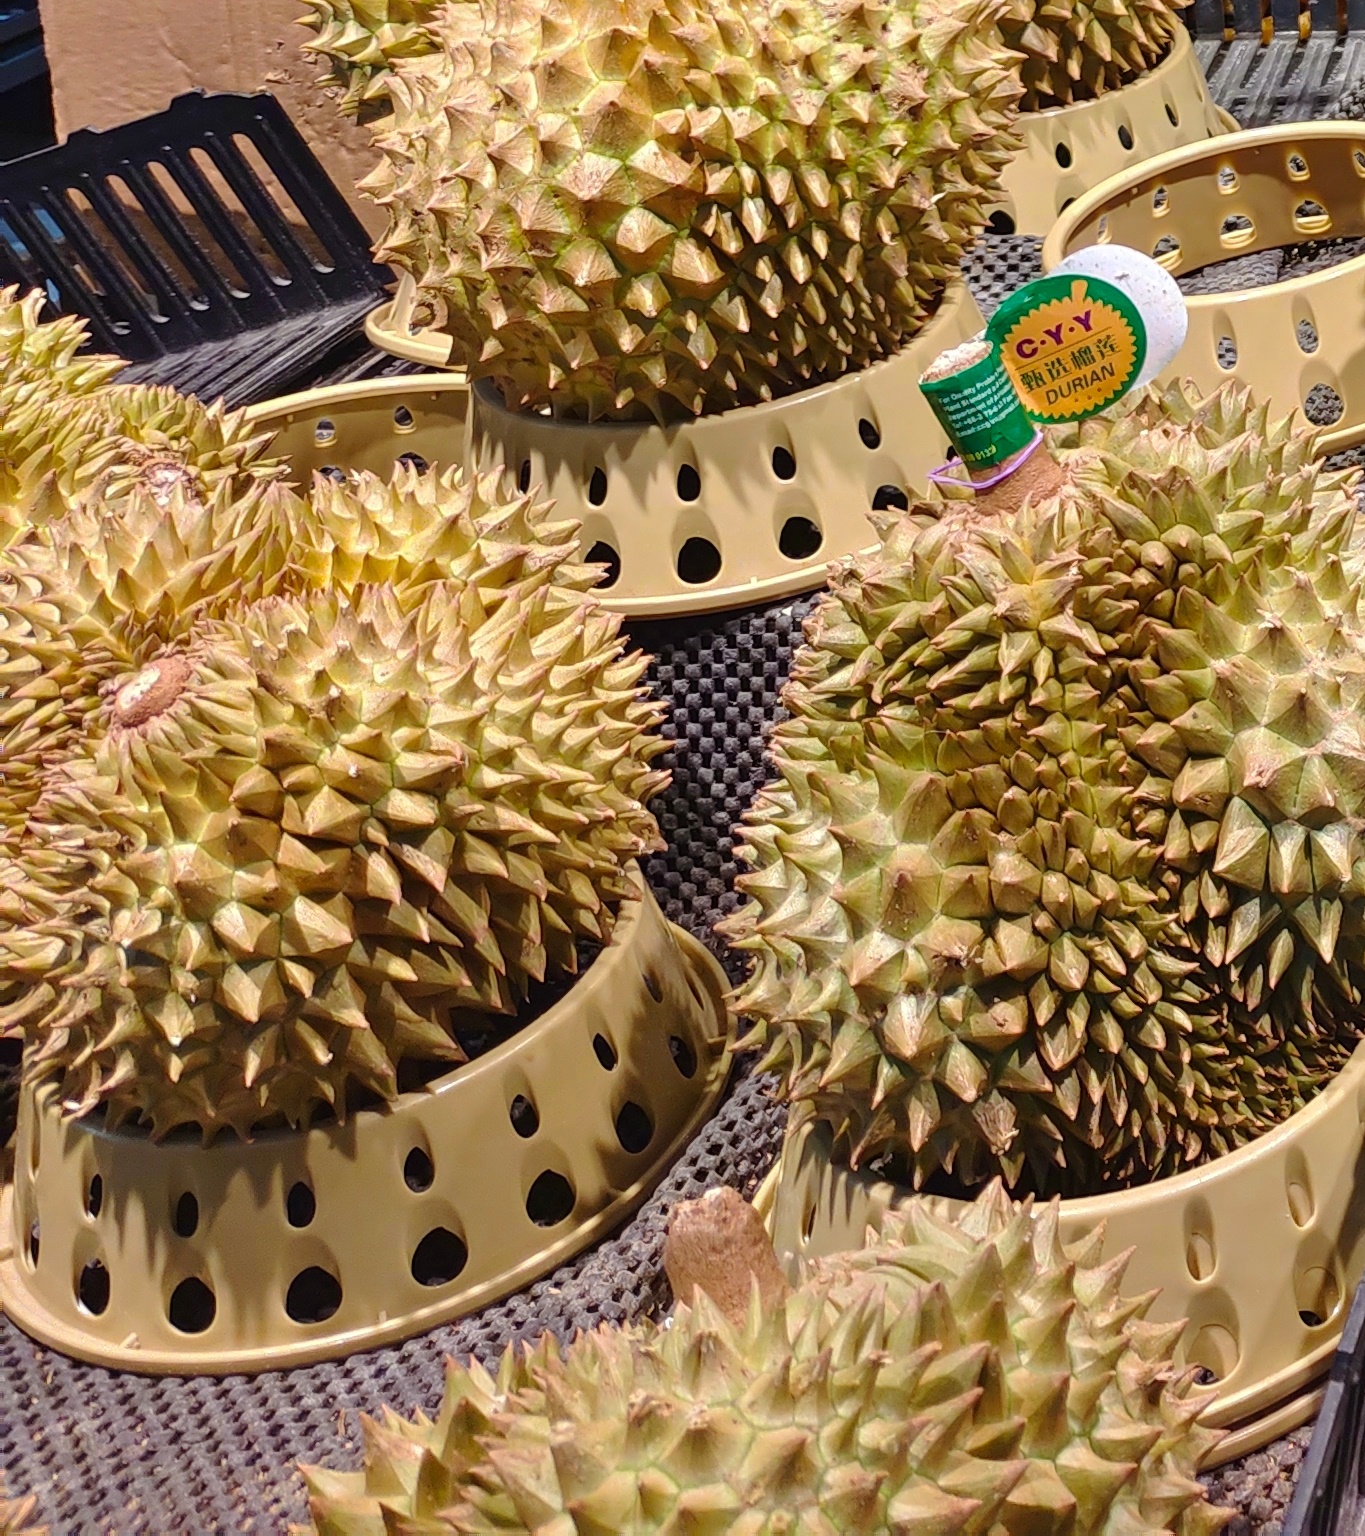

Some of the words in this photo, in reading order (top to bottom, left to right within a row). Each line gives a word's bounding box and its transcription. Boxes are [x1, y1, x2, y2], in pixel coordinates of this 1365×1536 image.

[1020, 334, 1122, 394] 甄选榴莲
[1045, 362, 1116, 406] DURIAN
